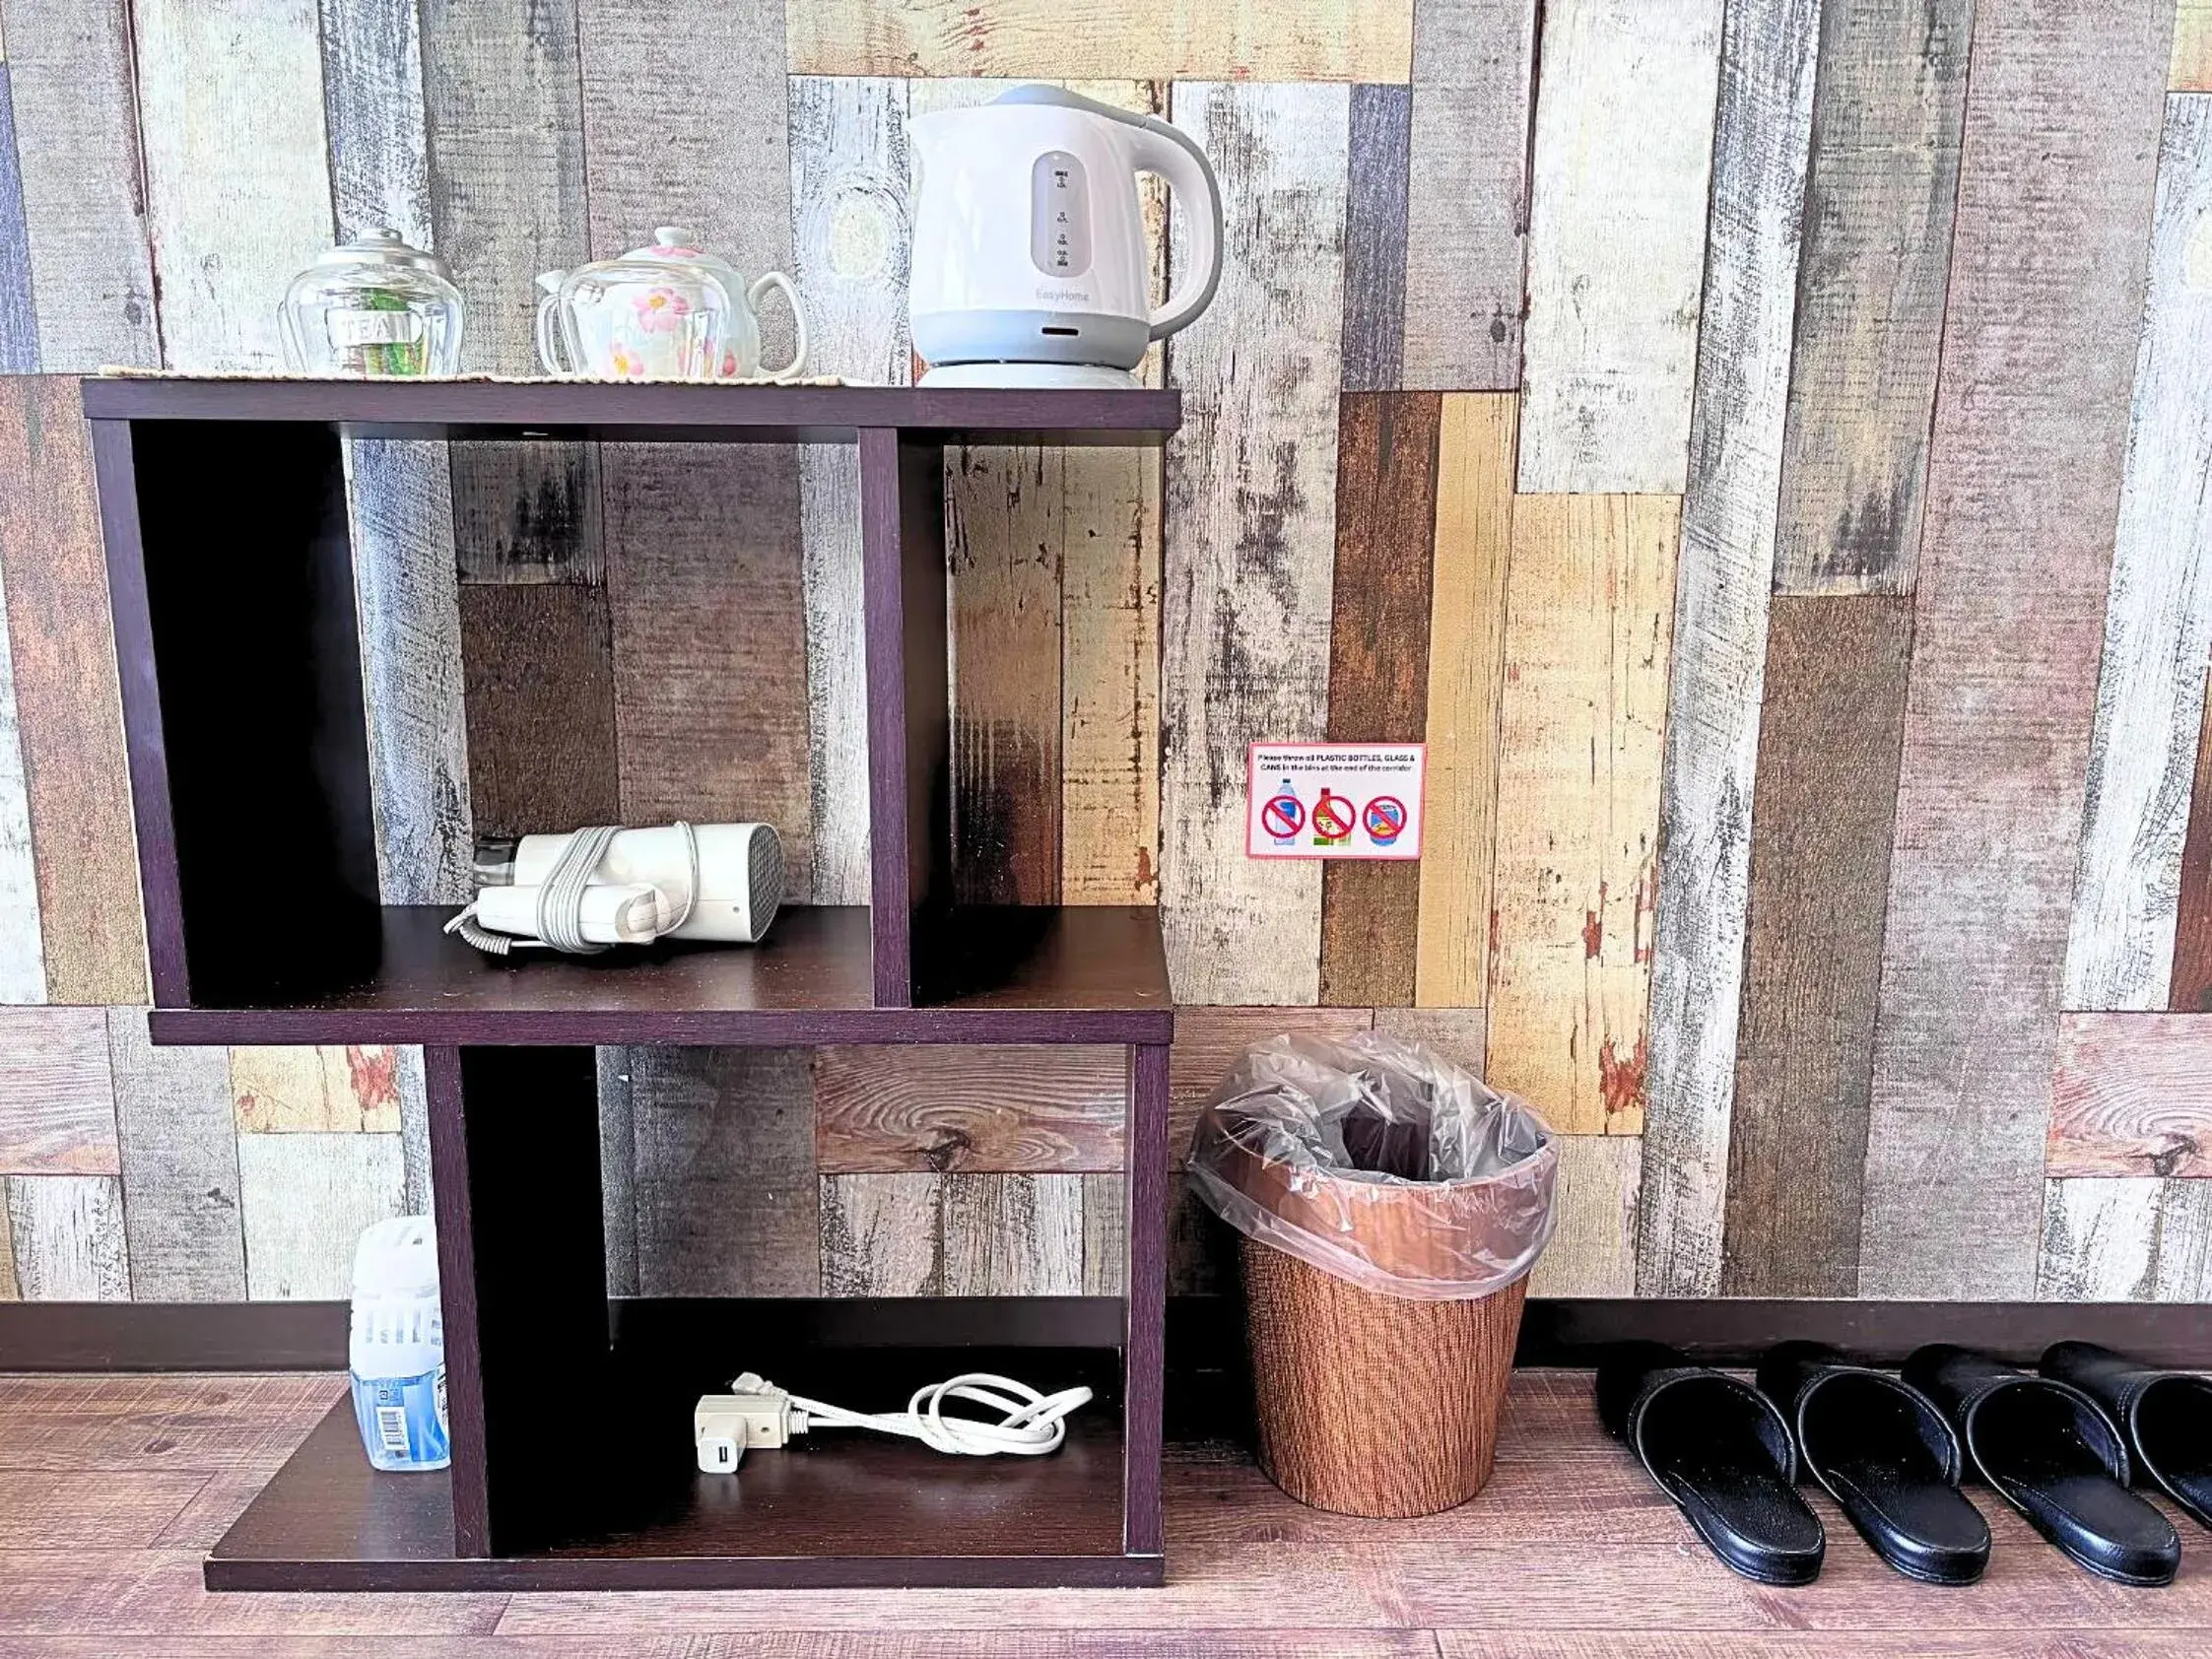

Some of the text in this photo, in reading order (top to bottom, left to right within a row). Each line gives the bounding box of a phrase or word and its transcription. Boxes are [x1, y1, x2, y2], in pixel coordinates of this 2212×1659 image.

[1036, 288, 1090, 301] EasyHome
[341, 316, 392, 339] TEA
[1348, 754, 1383, 763] BOTTLES,
